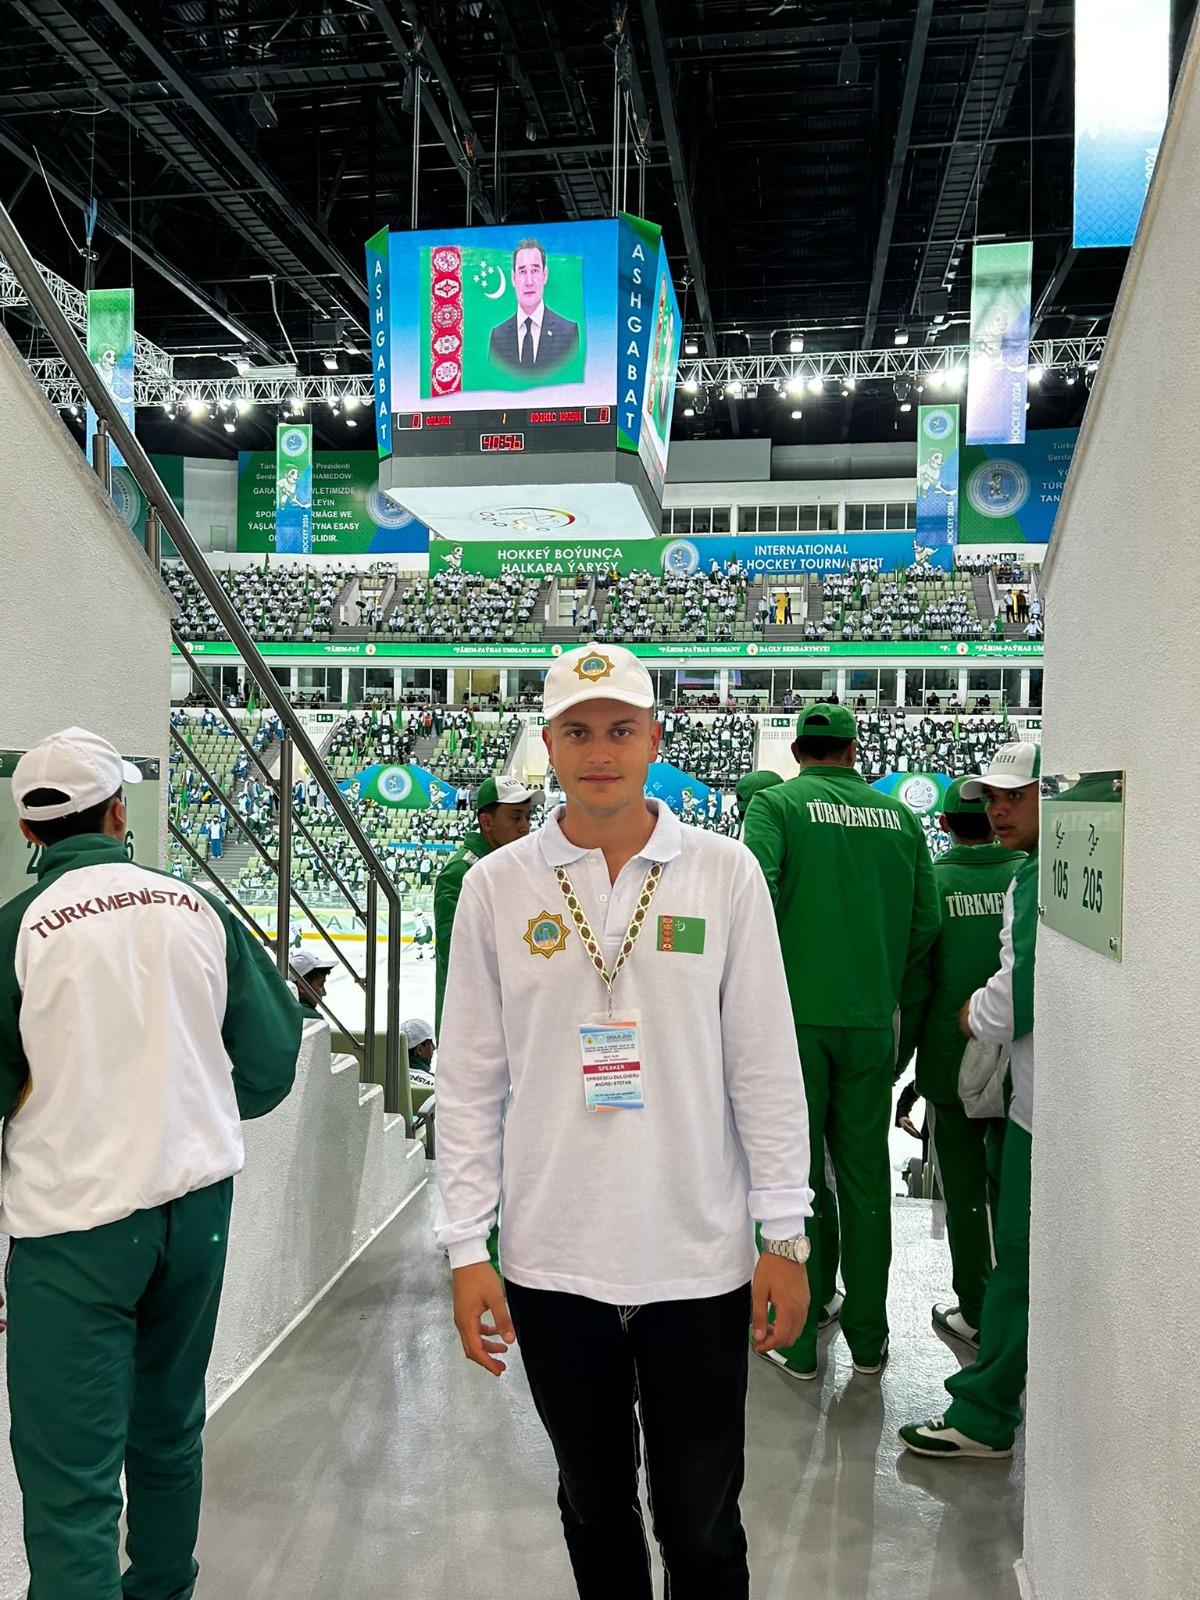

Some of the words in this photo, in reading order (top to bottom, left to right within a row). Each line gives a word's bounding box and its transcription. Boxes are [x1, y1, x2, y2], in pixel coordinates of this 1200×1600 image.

[624, 244, 645, 428] ASHGABAT
[374, 260, 387, 440] ASHGABAT
[311, 509, 338, 518] RMÄGE
[312, 522, 332, 530] TYNA
[334, 522, 360, 530] ESASY
[497, 546, 550, 560] HOKKEÝ
[554, 545, 623, 561] BOÝUNÇA
[754, 544, 848, 556] INTERNATIONAL
[501, 562, 563, 573] HALKARA
[723, 559, 743, 571] IE
[747, 559, 797, 570] HOCKEY
[806, 798, 902, 831] TÜRKMENISTAN
[1053, 858, 1068, 900] 105
[1082, 865, 1103, 914] 205
[598, 1064, 625, 1072] SPEAKER
